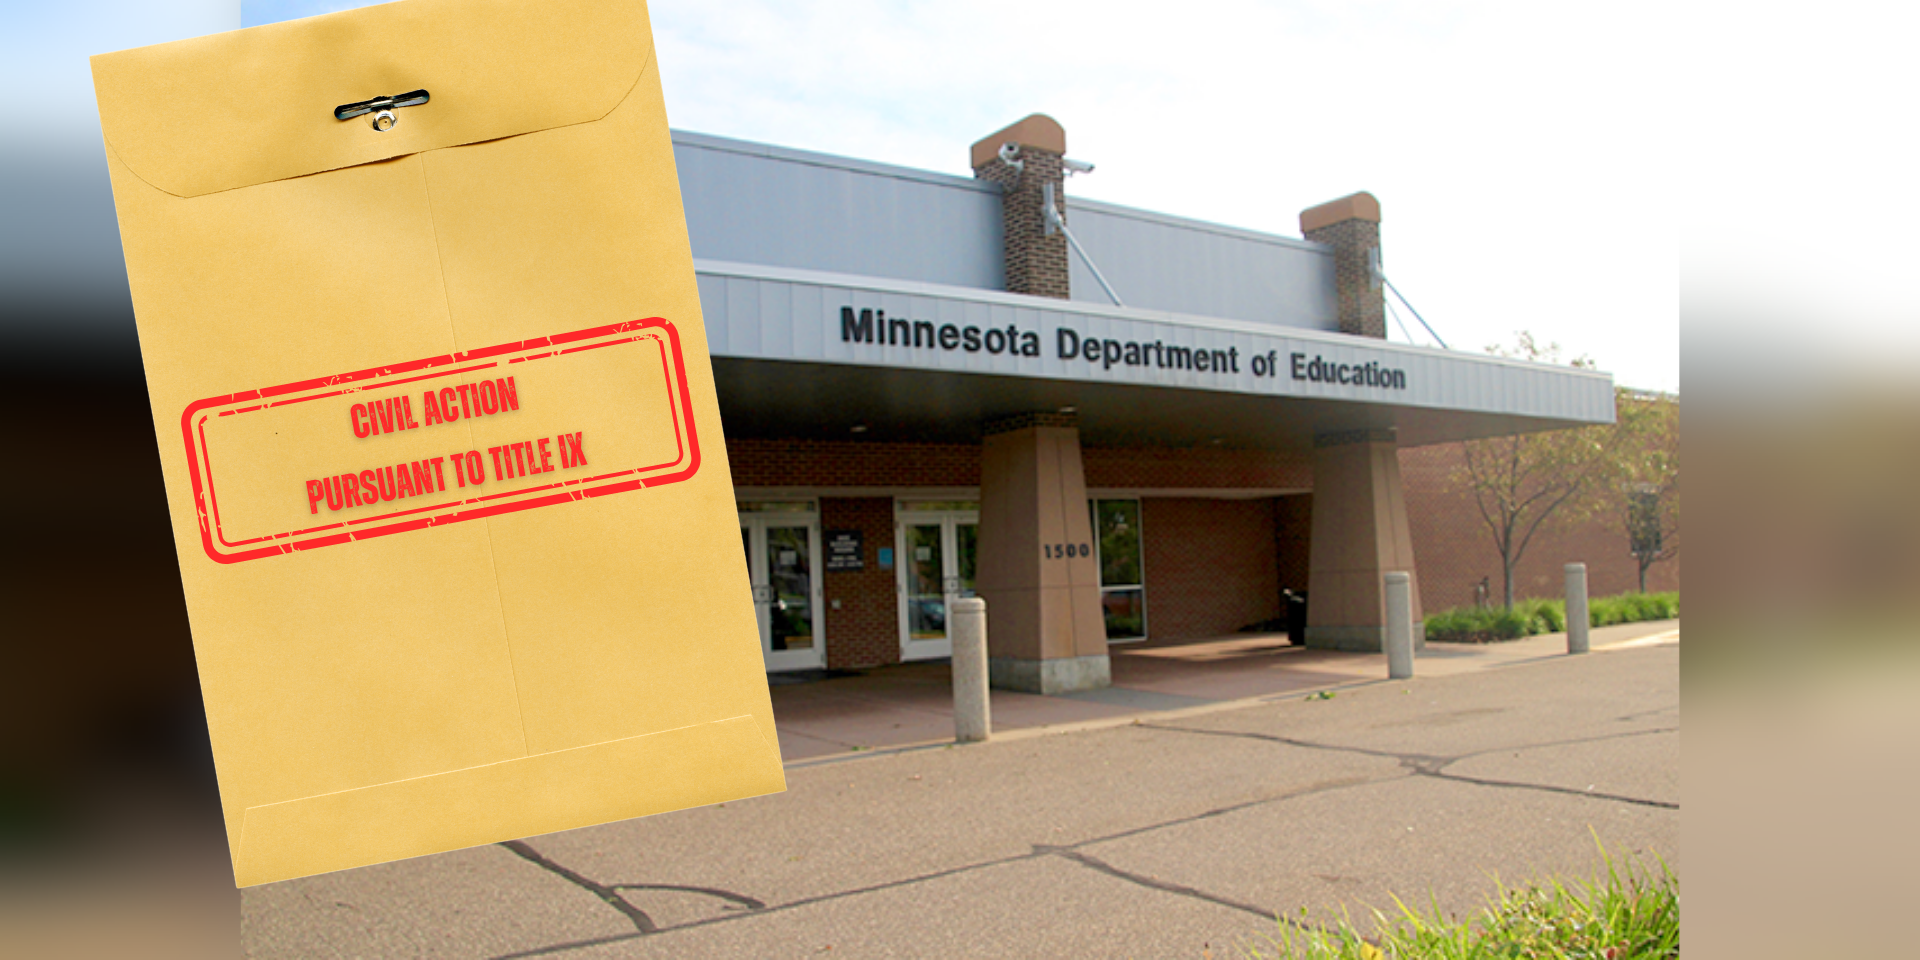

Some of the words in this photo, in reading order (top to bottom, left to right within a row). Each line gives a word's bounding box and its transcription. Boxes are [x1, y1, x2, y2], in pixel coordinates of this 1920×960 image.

[840, 306, 1040, 357] Minnesota
[1056, 327, 1240, 374] Department
[1251, 350, 1277, 377] of
[1290, 353, 1406, 389] Education
[1045, 543, 1090, 559] 1500
